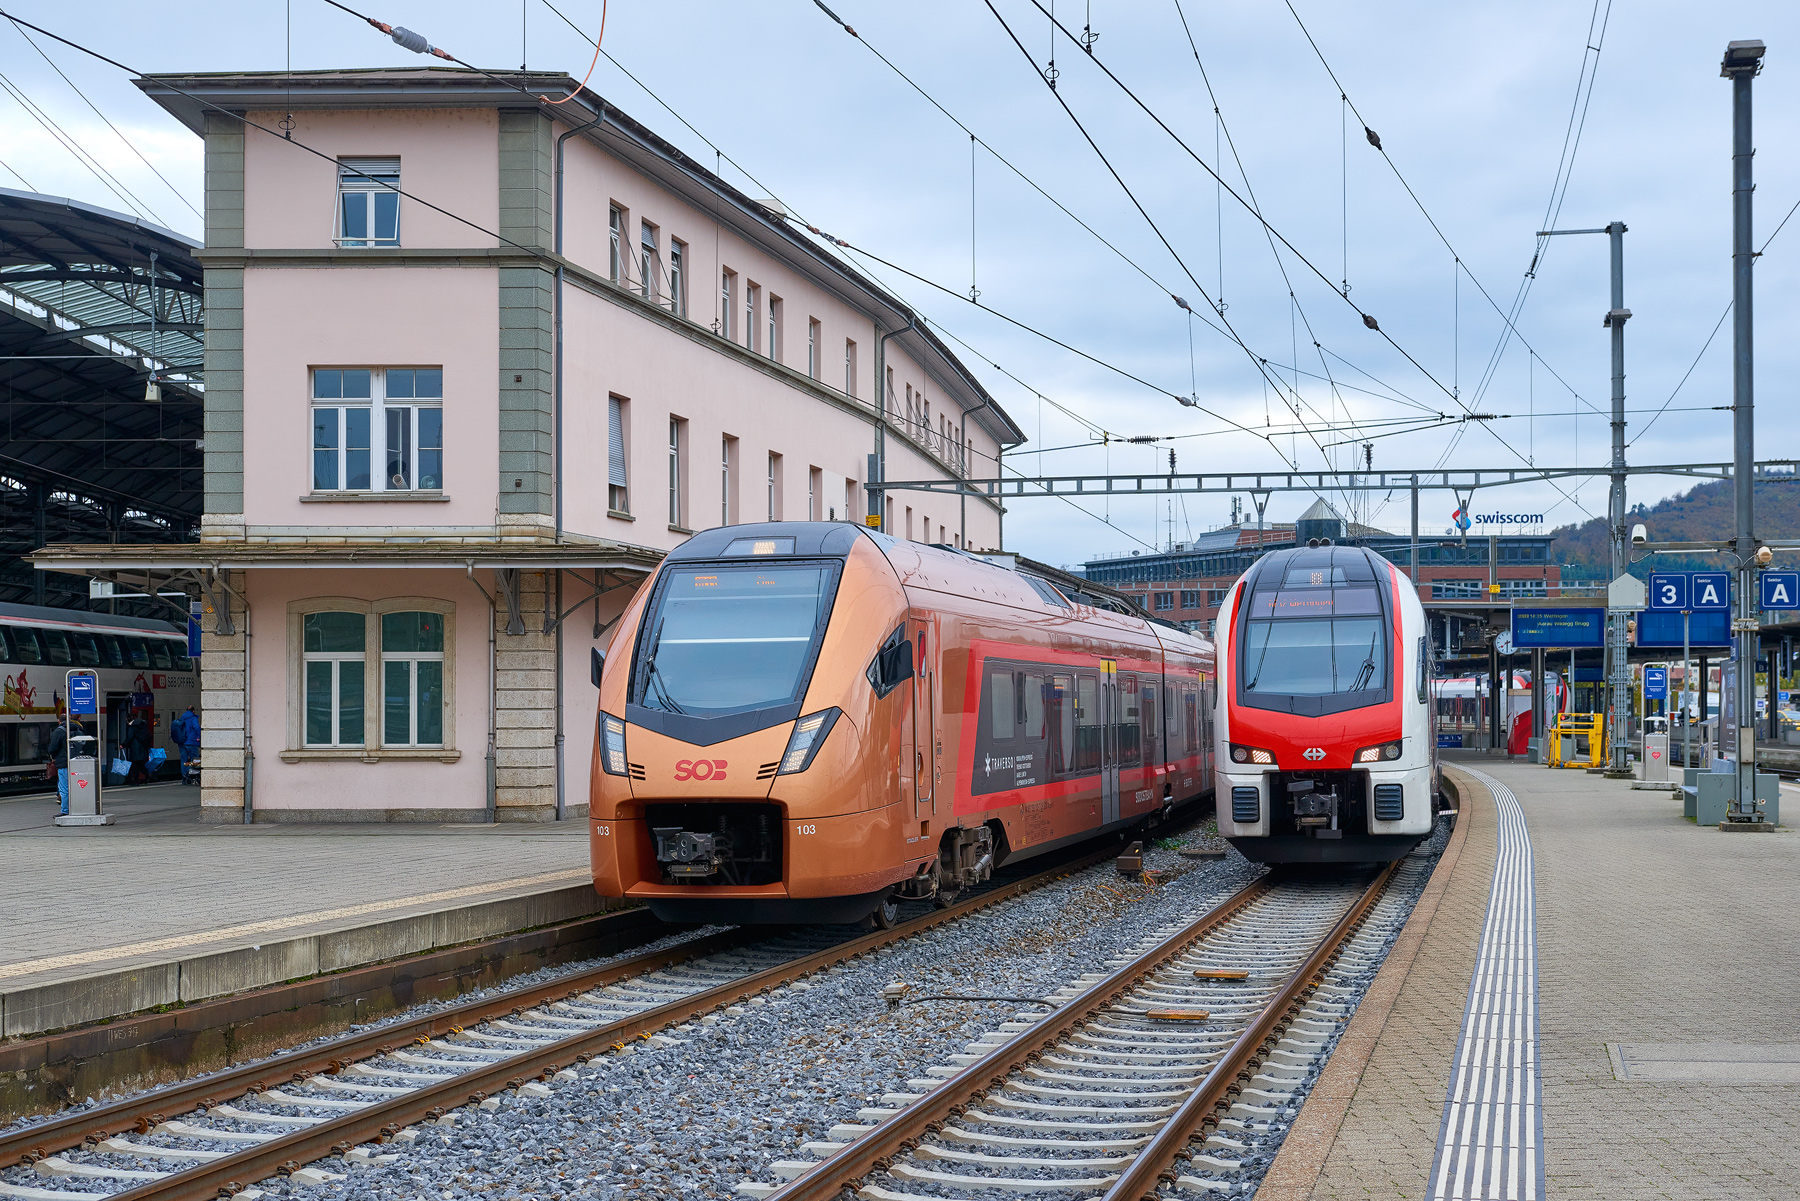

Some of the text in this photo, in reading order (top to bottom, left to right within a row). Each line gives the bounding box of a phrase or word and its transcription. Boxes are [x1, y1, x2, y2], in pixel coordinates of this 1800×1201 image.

[1475, 511, 1544, 524] swisscom
[1661, 584, 1677, 605] 3
[1701, 584, 1719, 604] A
[1771, 583, 1790, 603] A
[1575, 620, 1590, 628] Brugg
[673, 759, 728, 782] SOB
[991, 756, 1014, 771] TRAVERSO
[596, 825, 610, 836] 103
[796, 824, 816, 835] 103
